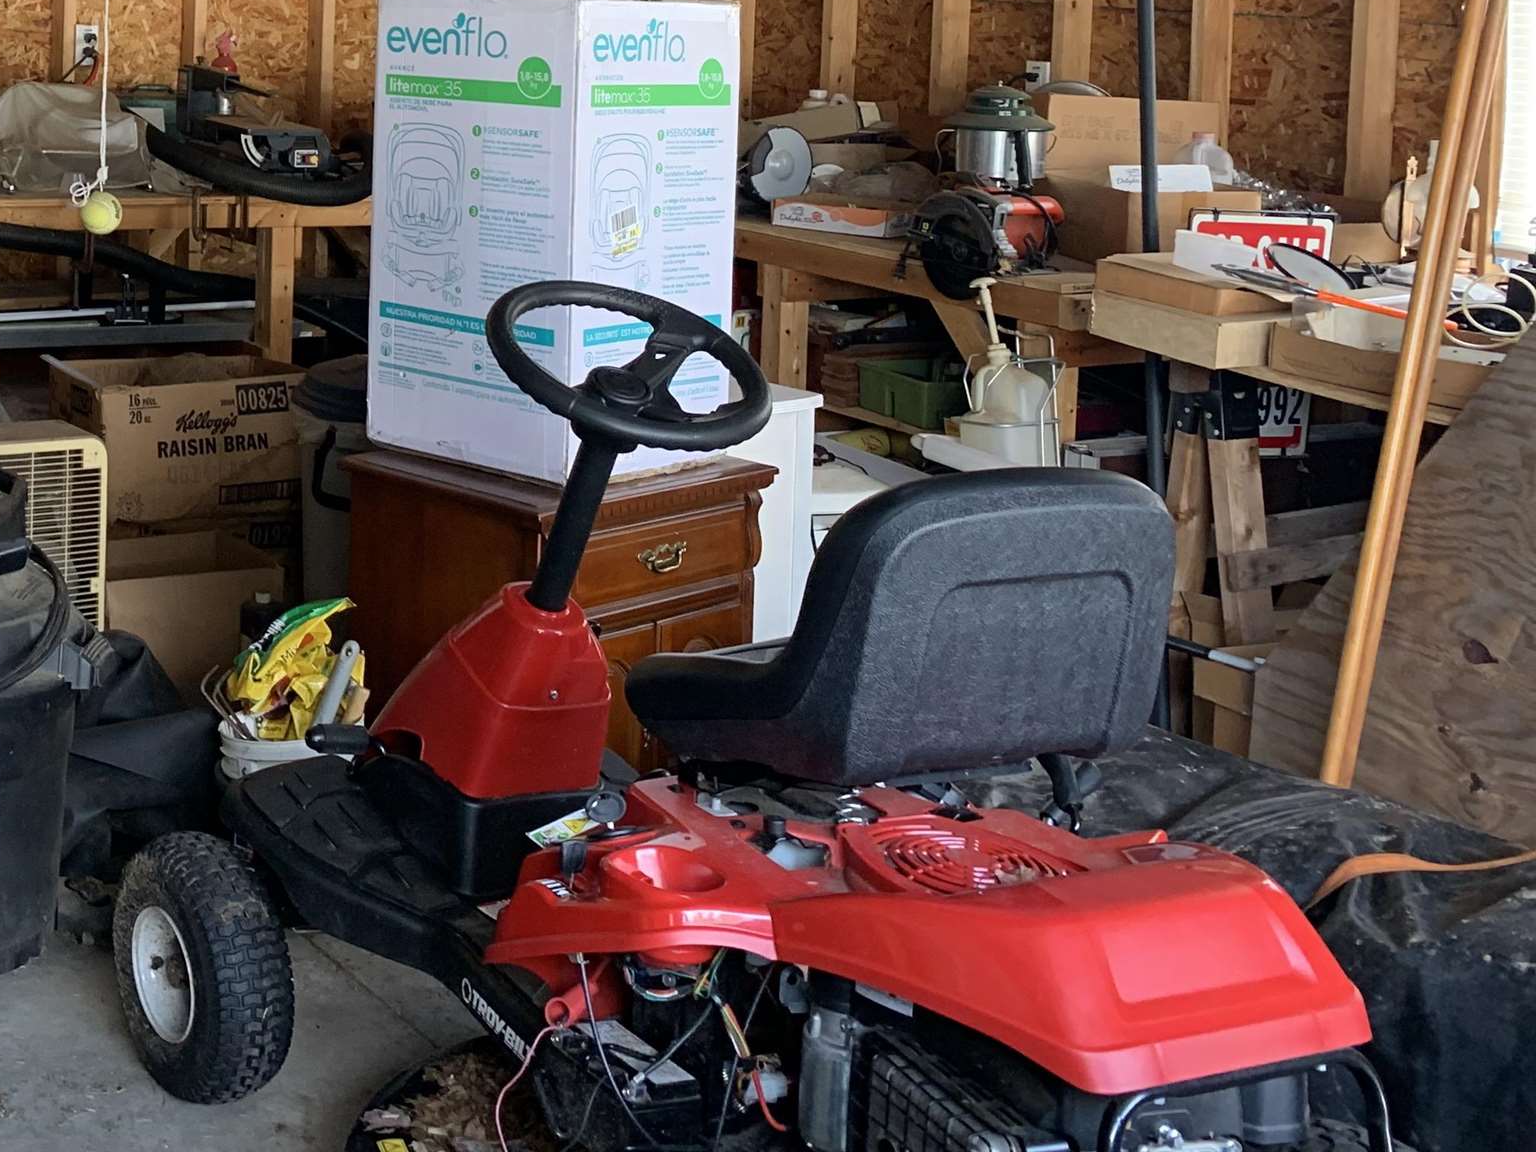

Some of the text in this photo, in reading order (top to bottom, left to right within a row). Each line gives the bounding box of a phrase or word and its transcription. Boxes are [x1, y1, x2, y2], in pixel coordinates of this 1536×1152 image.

[386, 15, 507, 58] evenflo
[593, 20, 685, 62] evenflo
[443, 80, 462, 97] 35
[637, 88, 650, 103] 35
[129, 394, 140, 407] 16
[237, 386, 288, 411] 00825
[129, 411, 142, 424] 20
[175, 409, 238, 435] Kellogg's
[157, 432, 269, 458] RAISIN BRAN
